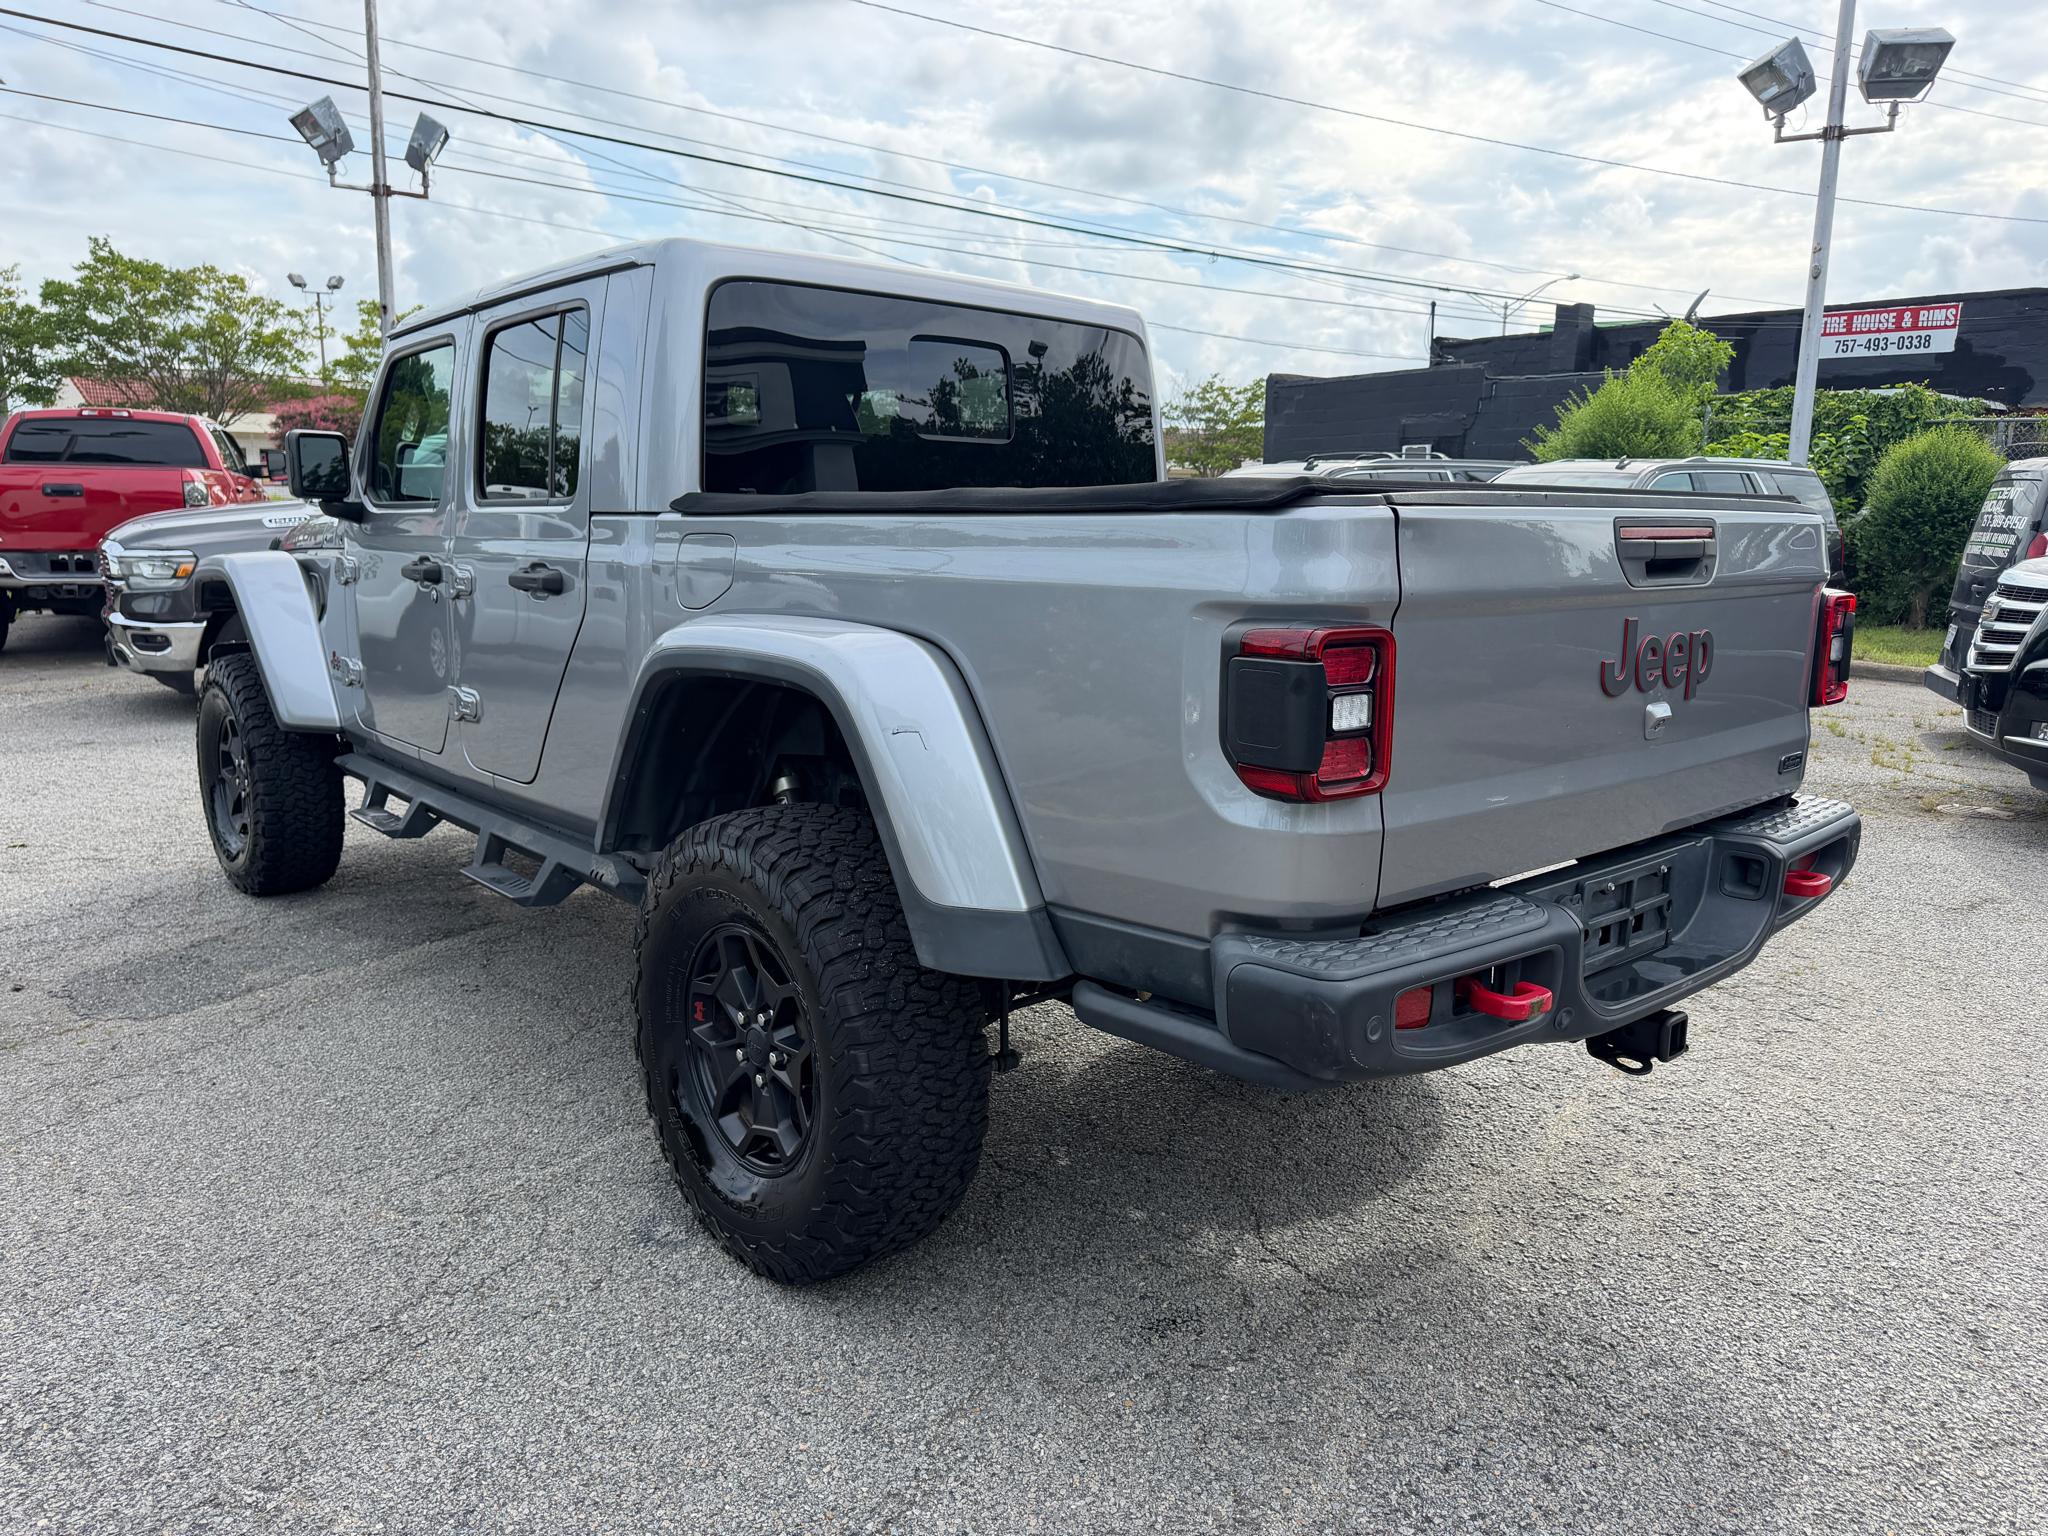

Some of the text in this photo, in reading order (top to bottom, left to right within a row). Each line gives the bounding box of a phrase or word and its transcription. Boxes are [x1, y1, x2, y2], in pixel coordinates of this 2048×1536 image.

[1821, 308, 1956, 334] TIRE HOUSE & RIMS
[1834, 334, 1932, 354] 757-493-0338
[1600, 616, 1715, 701] Jeep
